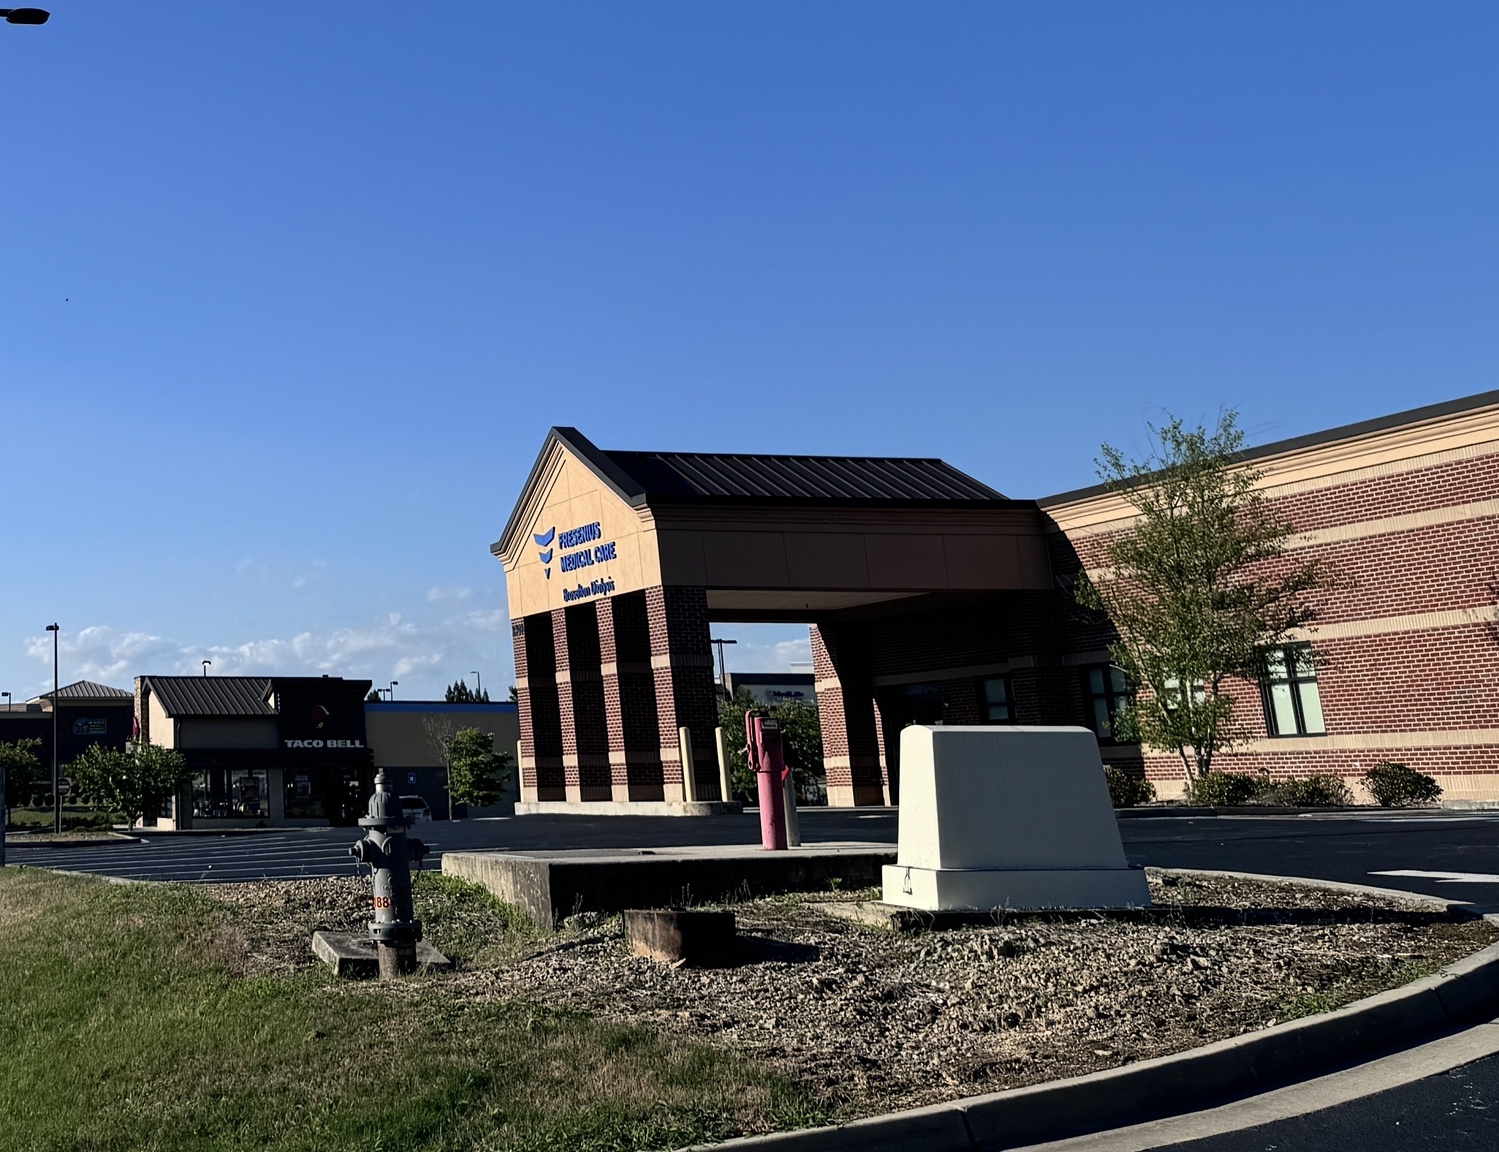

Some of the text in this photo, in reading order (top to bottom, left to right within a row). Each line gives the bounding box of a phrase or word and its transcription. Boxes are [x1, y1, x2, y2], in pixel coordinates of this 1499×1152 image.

[558, 521, 601, 550] FRESENIUS
[560, 541, 617, 573] MEDICAL CARE
[284, 740, 364, 748] TACO BELL
